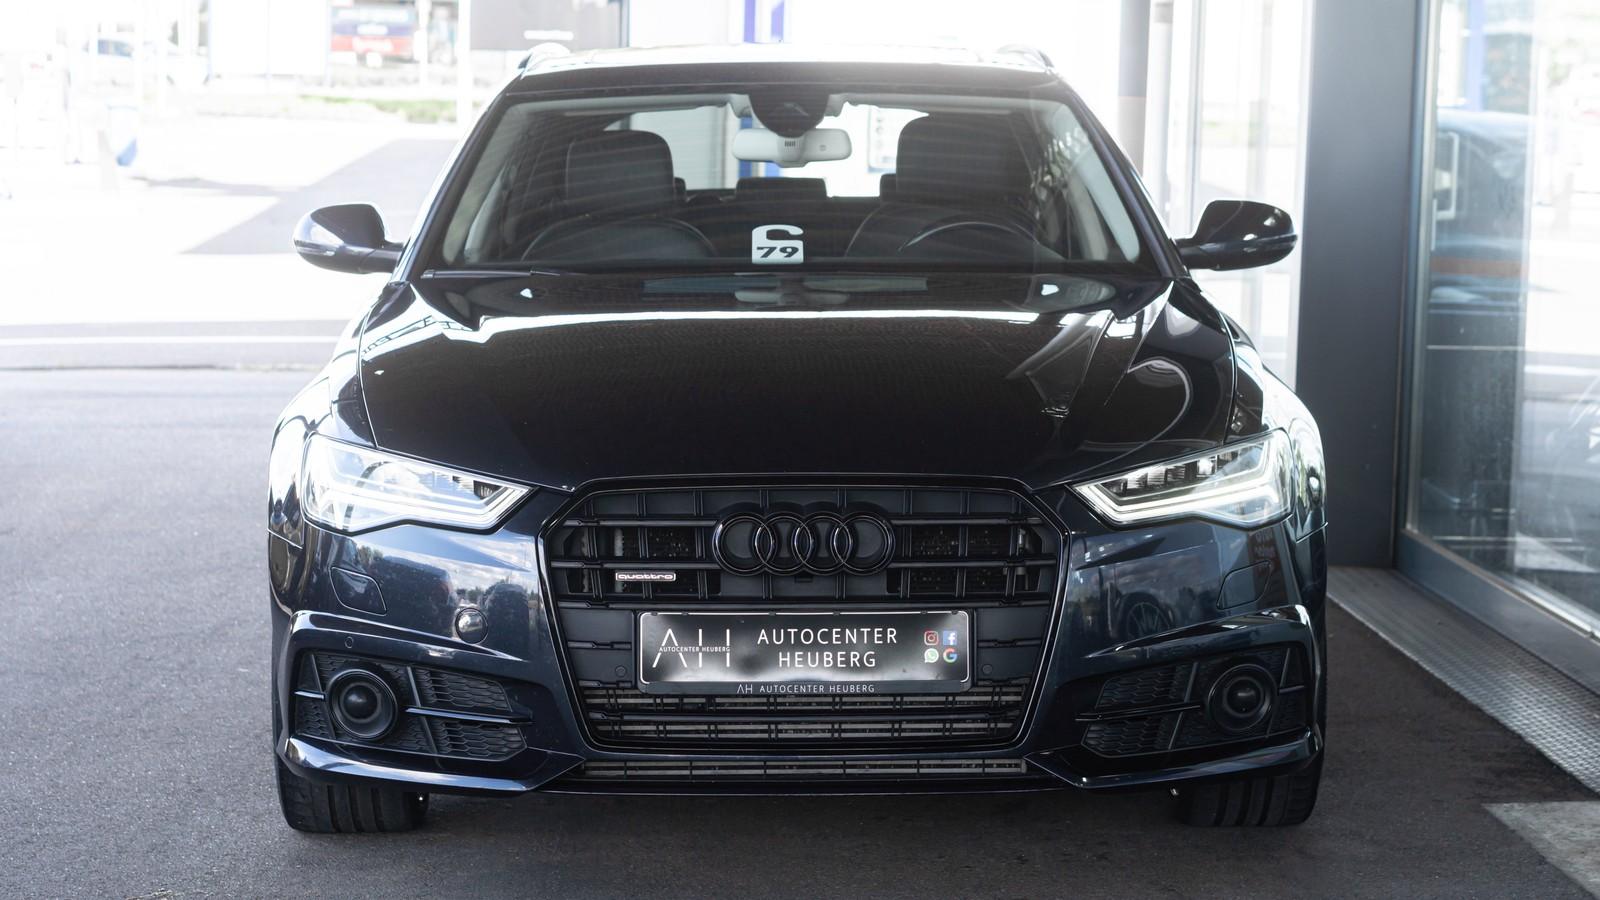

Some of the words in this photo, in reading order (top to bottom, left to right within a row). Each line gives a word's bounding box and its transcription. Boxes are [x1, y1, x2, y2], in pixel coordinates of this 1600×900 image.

[756, 246, 799, 258] 79
[757, 628, 898, 645] AUTOCENTER
[778, 651, 876, 668] HEUBERG
[736, 684, 753, 694] AH
[759, 684, 825, 694] AUTOCENTER
[829, 684, 875, 693] HEUBERG
